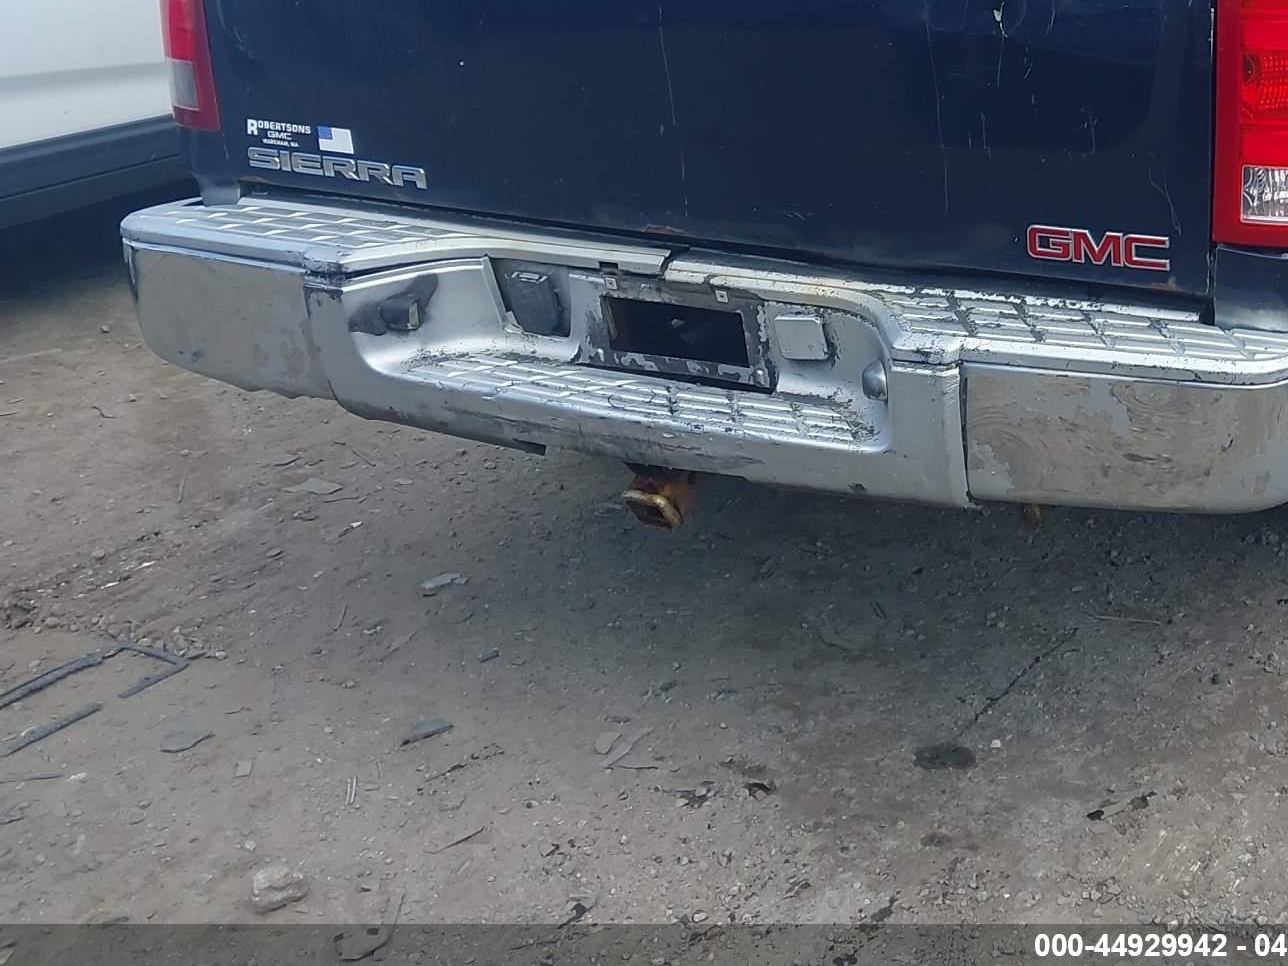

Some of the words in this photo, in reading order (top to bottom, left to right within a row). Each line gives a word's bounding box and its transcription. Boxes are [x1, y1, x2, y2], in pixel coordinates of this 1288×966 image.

[247, 119, 312, 135] ROBERTSONS
[267, 131, 292, 140] GMC
[248, 146, 428, 190] SIERRA
[1027, 224, 1170, 271] GMC
